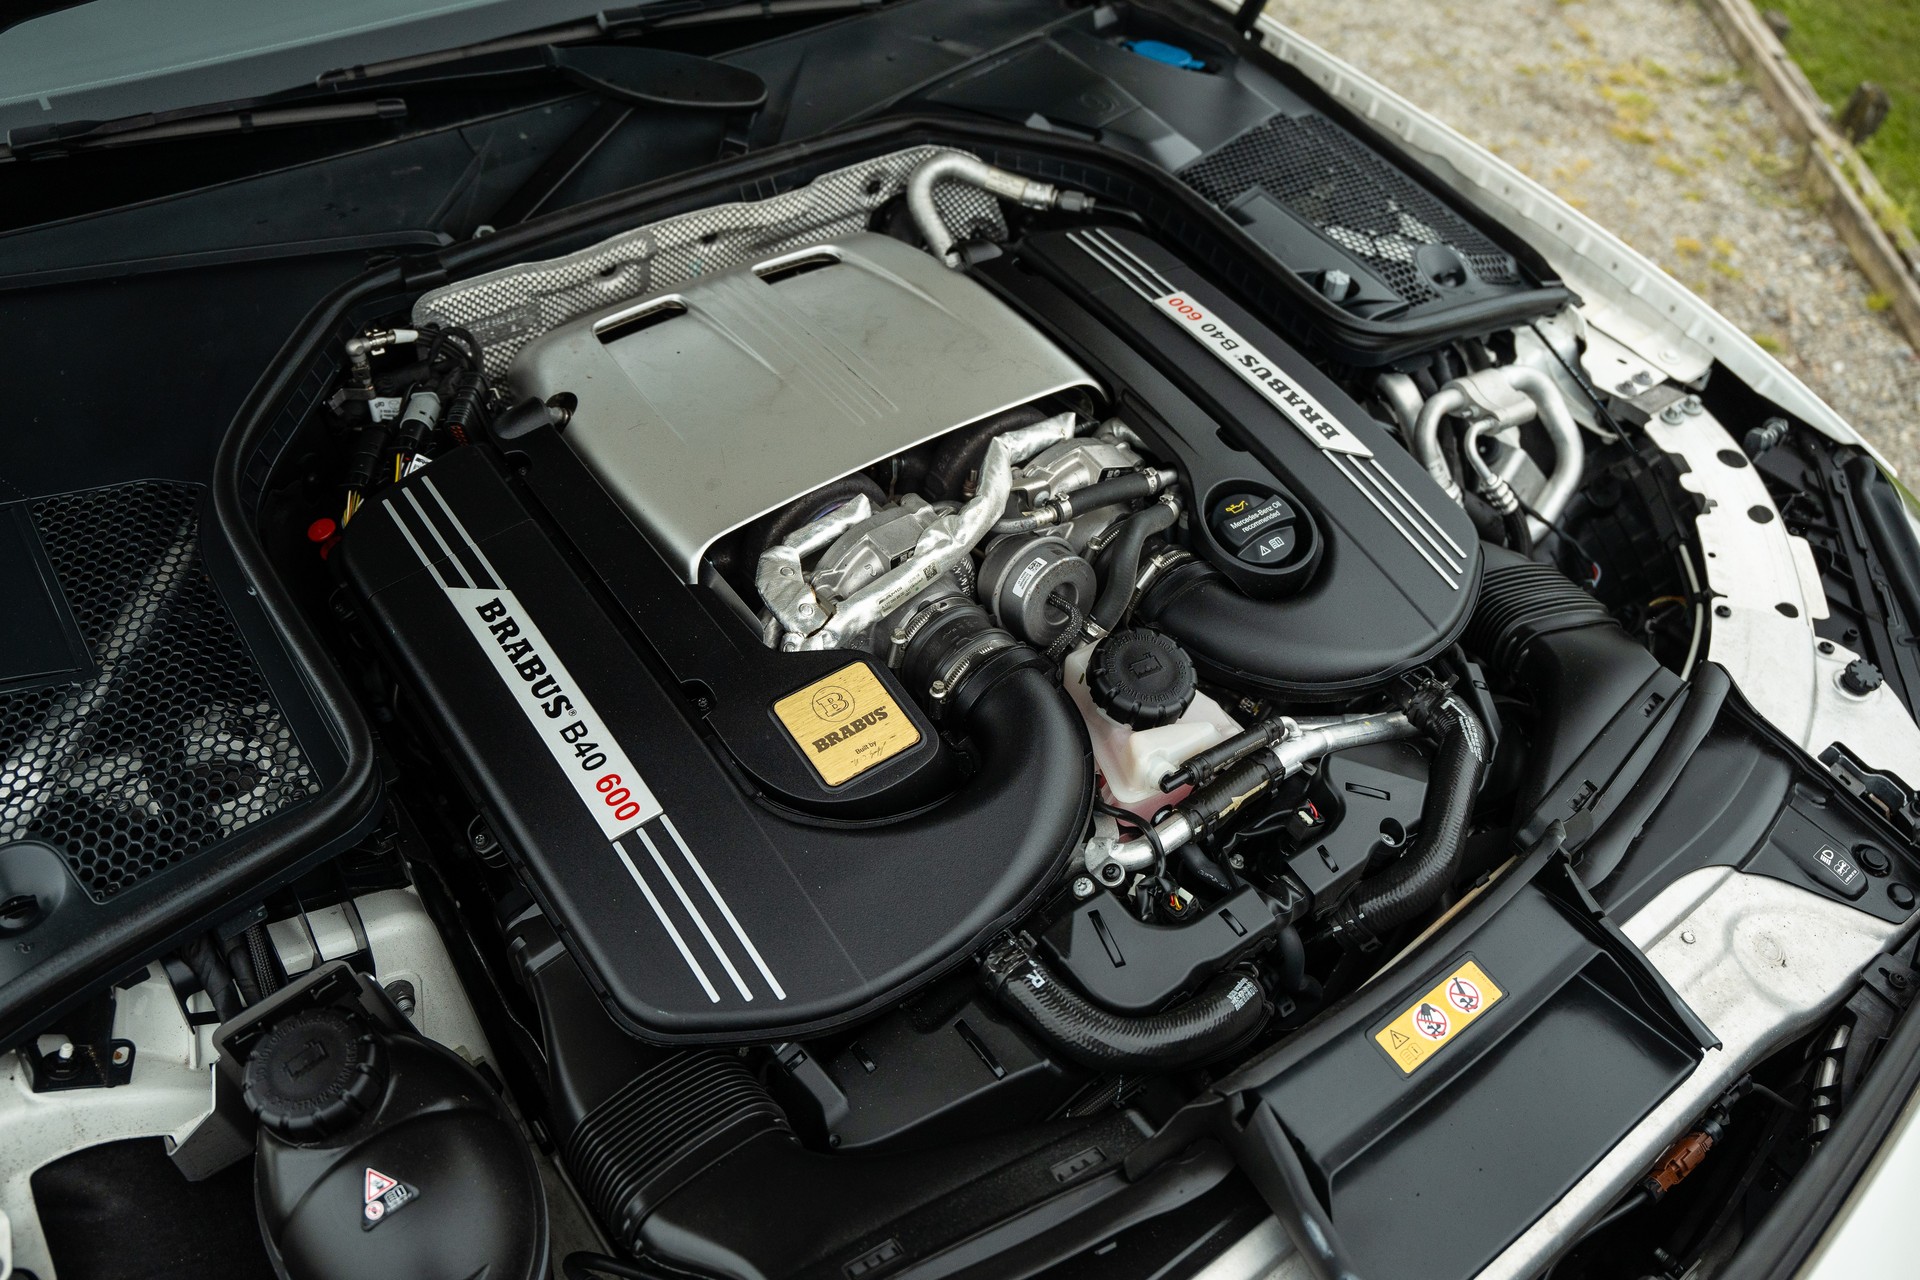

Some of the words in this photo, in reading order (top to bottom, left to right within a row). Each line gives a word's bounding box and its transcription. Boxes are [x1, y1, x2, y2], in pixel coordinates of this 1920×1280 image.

[1168, 297, 1202, 321] 600
[1201, 323, 1239, 351] B40
[1230, 505, 1273, 529] Mercedes-Benz
[1272, 500, 1282, 509] Oil
[1242, 510, 1281, 532] recommended
[855, 744, 869, 755] Built
[559, 720, 607, 771] B40
[595, 773, 640, 821] 600
